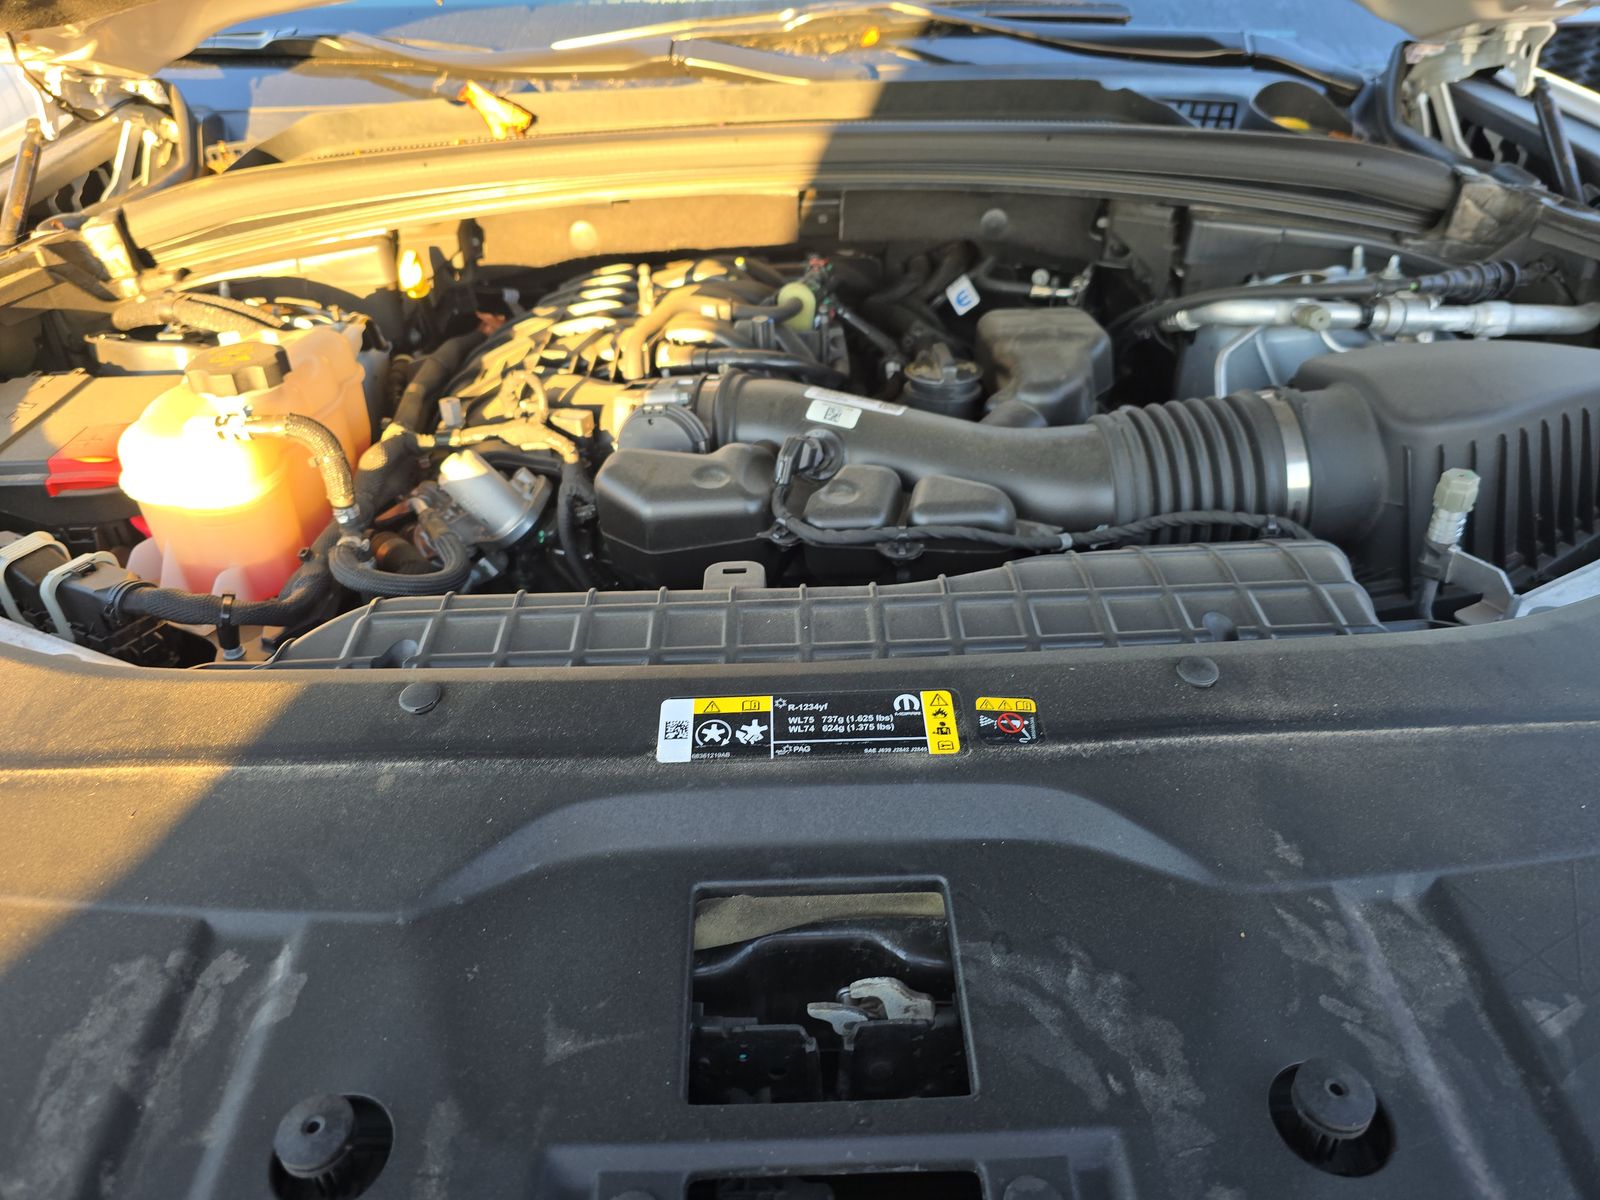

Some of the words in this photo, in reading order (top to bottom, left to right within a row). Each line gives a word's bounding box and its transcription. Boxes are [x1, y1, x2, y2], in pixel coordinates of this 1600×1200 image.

[787, 702, 829, 711] R-1234yf
[787, 716, 815, 724] WL75
[821, 715, 845, 724] 737g
[846, 714, 873, 724] (1.625
[875, 714, 894, 723] lbs)
[788, 725, 816, 733] WL74
[822, 724, 845, 733] 624g
[846, 723, 875, 733] (1.375
[876, 722, 895, 731] lbs)
[793, 745, 811, 753] PAG
